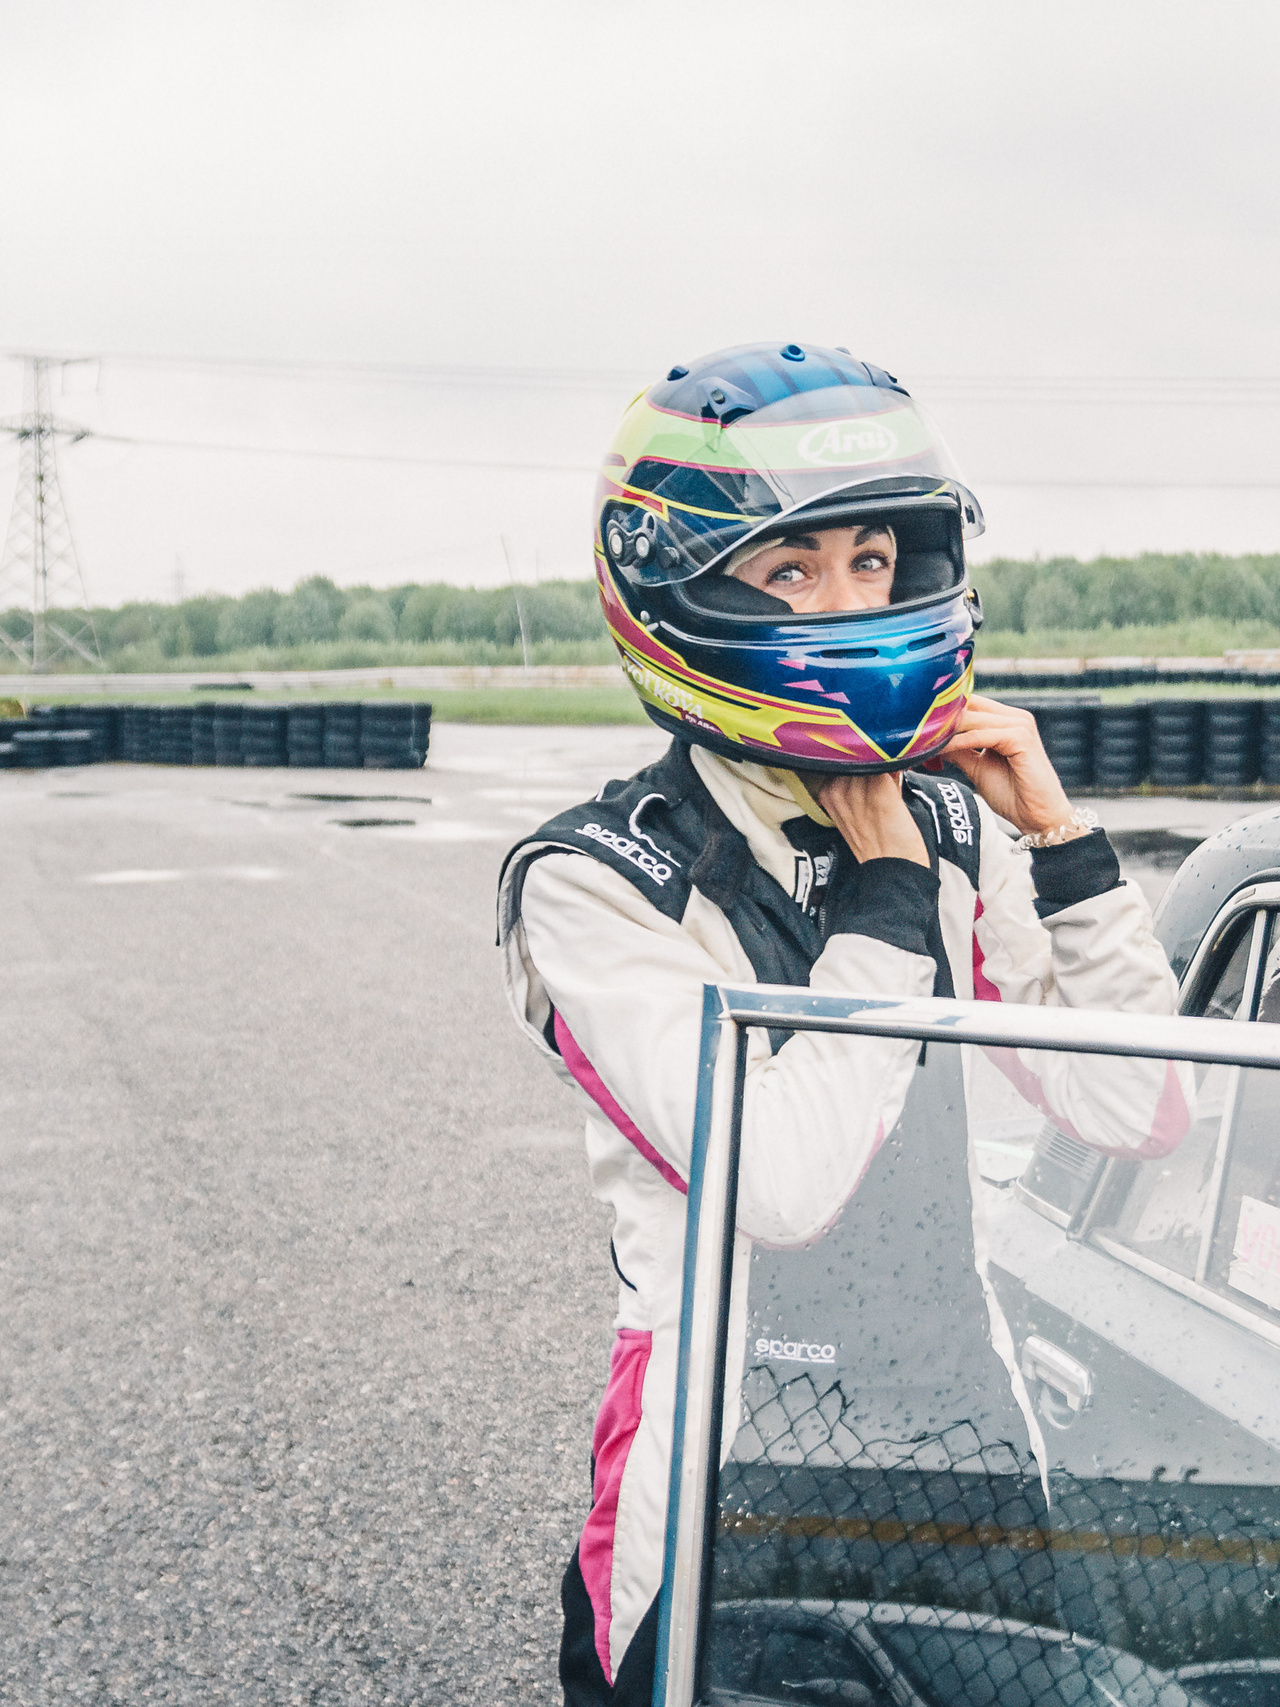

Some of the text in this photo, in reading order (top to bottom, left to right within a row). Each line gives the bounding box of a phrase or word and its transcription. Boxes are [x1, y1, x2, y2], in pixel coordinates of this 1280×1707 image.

[819, 426, 888, 455] Arai
[937, 782, 973, 845] sparco
[576, 822, 673, 884] sparco
[754, 1337, 837, 1363] sparco
